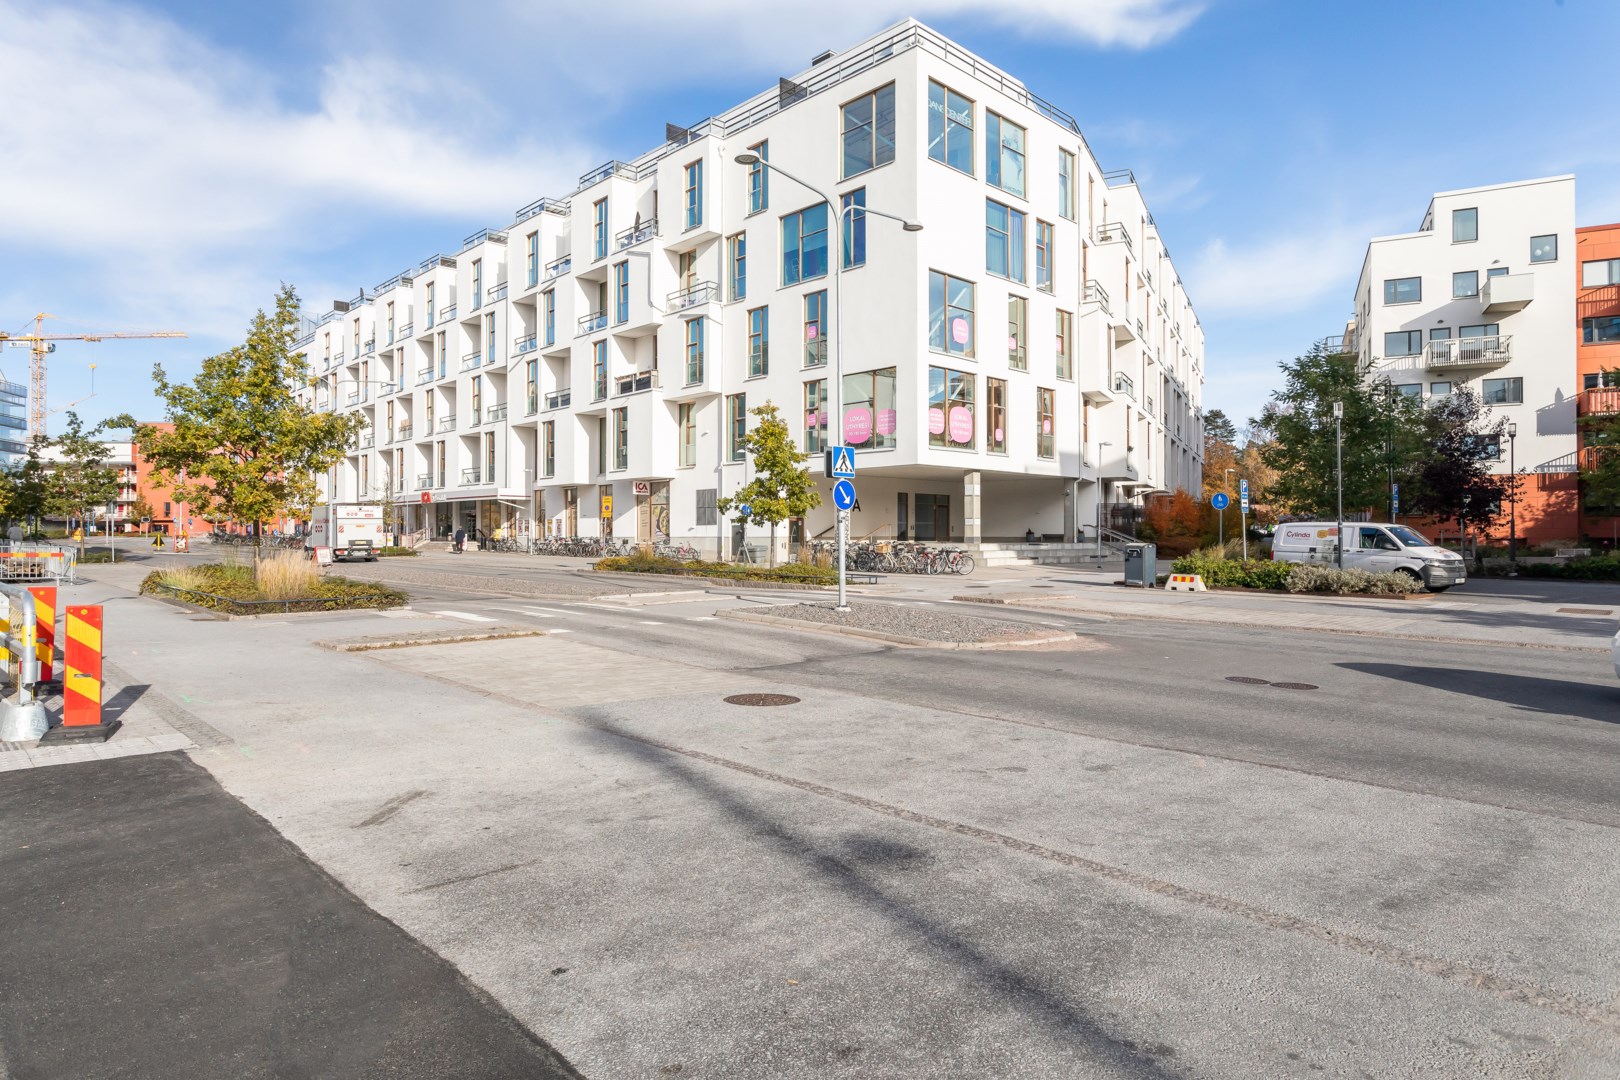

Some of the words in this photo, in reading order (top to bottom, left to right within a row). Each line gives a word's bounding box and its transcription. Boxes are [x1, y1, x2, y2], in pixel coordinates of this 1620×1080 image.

[635, 482, 648, 490] ICA
[852, 498, 861, 512] A
[1286, 530, 1311, 538] Cylinda
